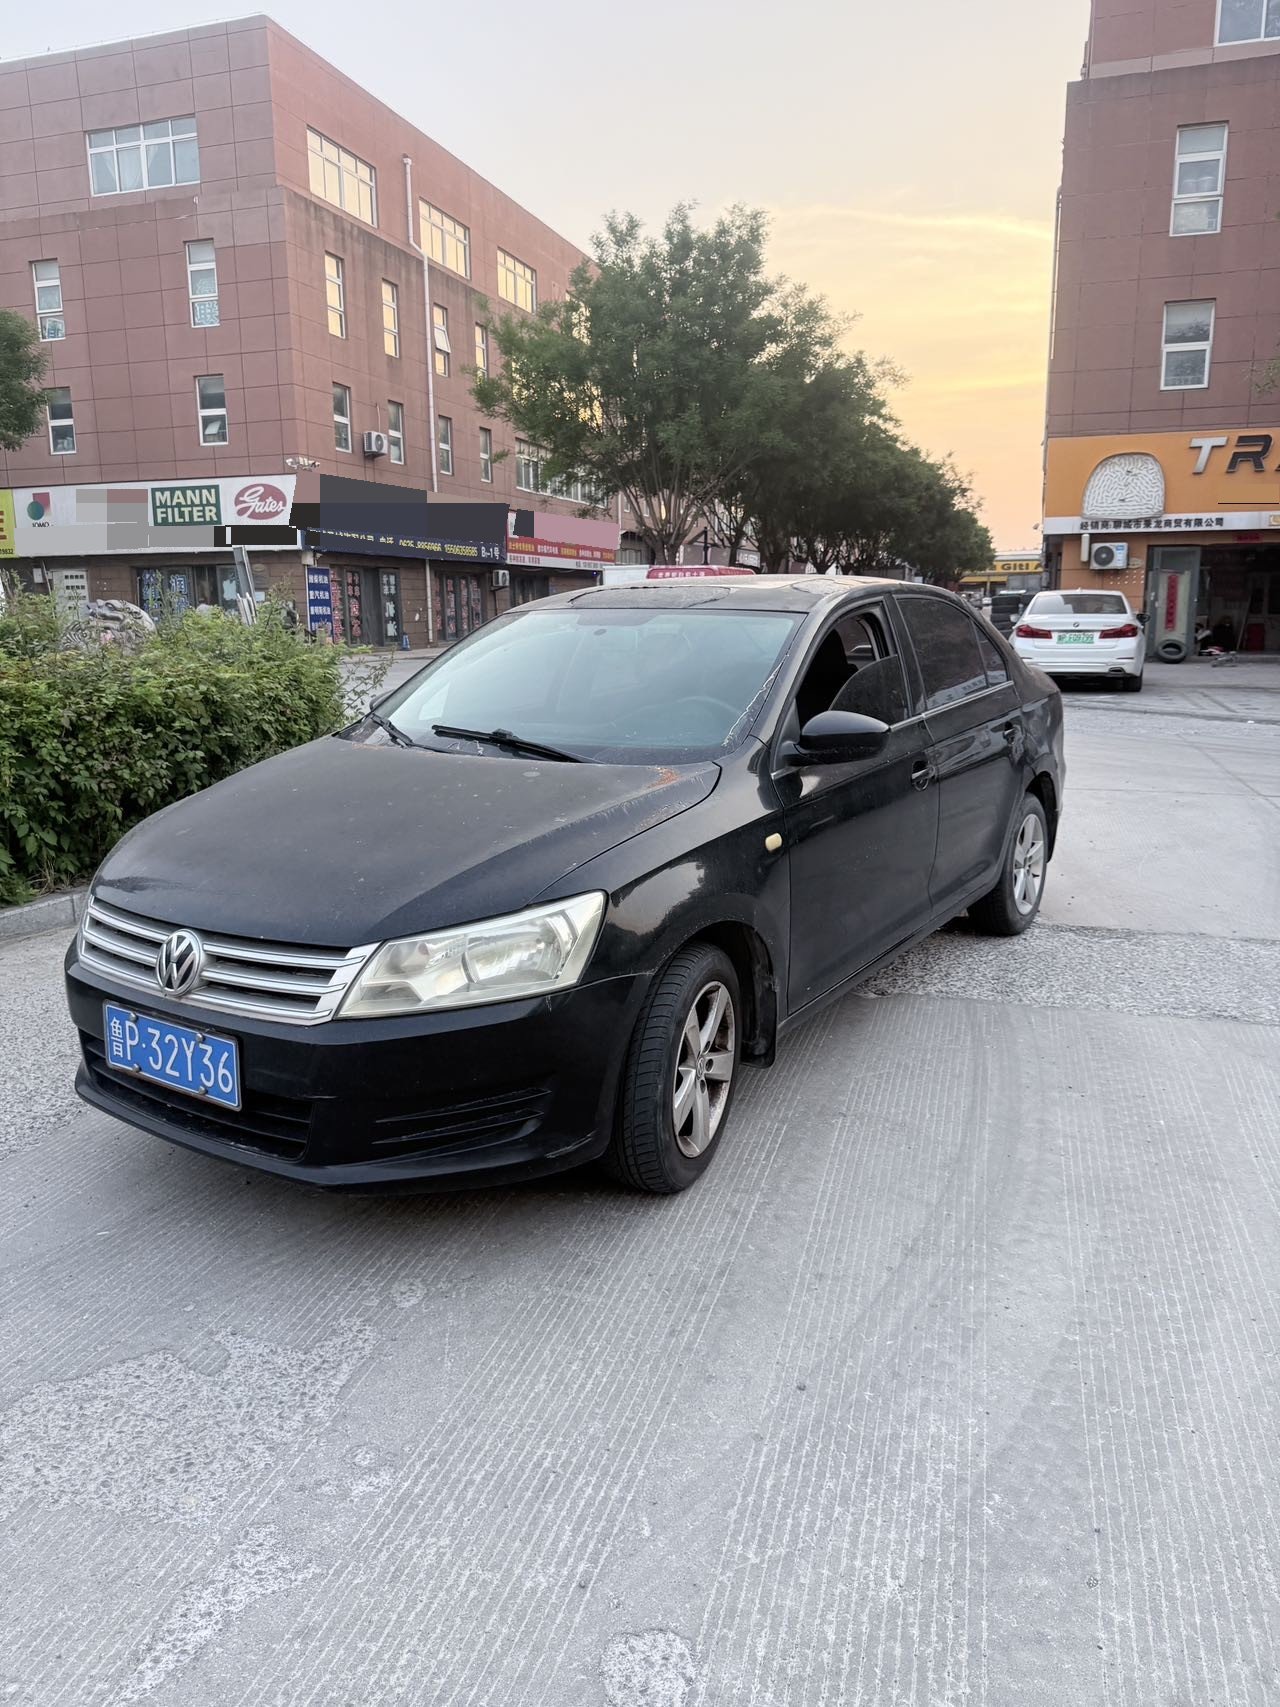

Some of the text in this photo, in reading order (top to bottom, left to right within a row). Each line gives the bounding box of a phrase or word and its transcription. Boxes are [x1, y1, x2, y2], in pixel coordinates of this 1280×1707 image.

[1188, 435, 1280, 475] TR
[155, 488, 216, 506] MANN
[236, 486, 285, 518] Gates
[156, 506, 218, 523] FILTER
